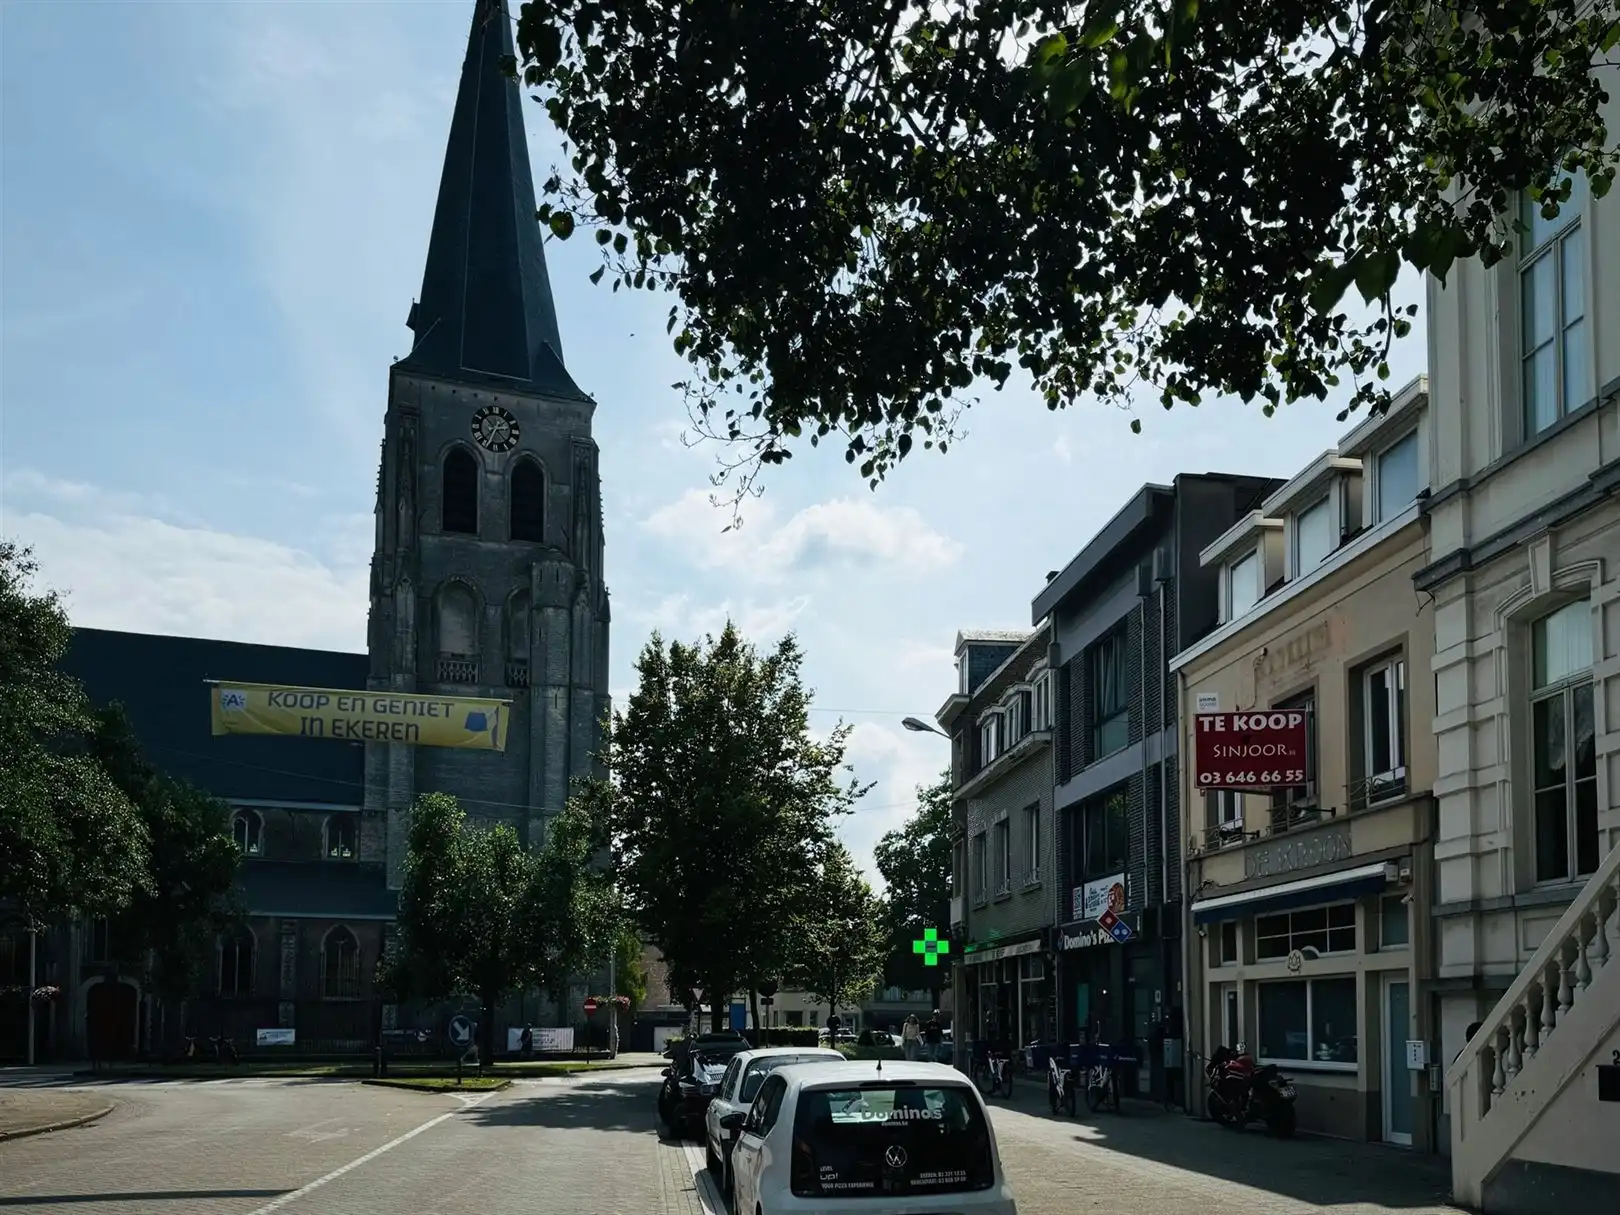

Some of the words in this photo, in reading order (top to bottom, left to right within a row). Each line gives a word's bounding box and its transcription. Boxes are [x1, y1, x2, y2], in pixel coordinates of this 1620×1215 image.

[268, 692, 330, 710] KOOP
[1199, 716, 1226, 732] TE
[1233, 714, 1302, 731] KOOP
[1200, 772, 1221, 784] 03
[1226, 771, 1256, 783] 646
[1261, 770, 1281, 782] 66
[1285, 769, 1304, 782] 55
[1278, 833, 1353, 872] KROON
[1064, 930, 1098, 950] Domino's
